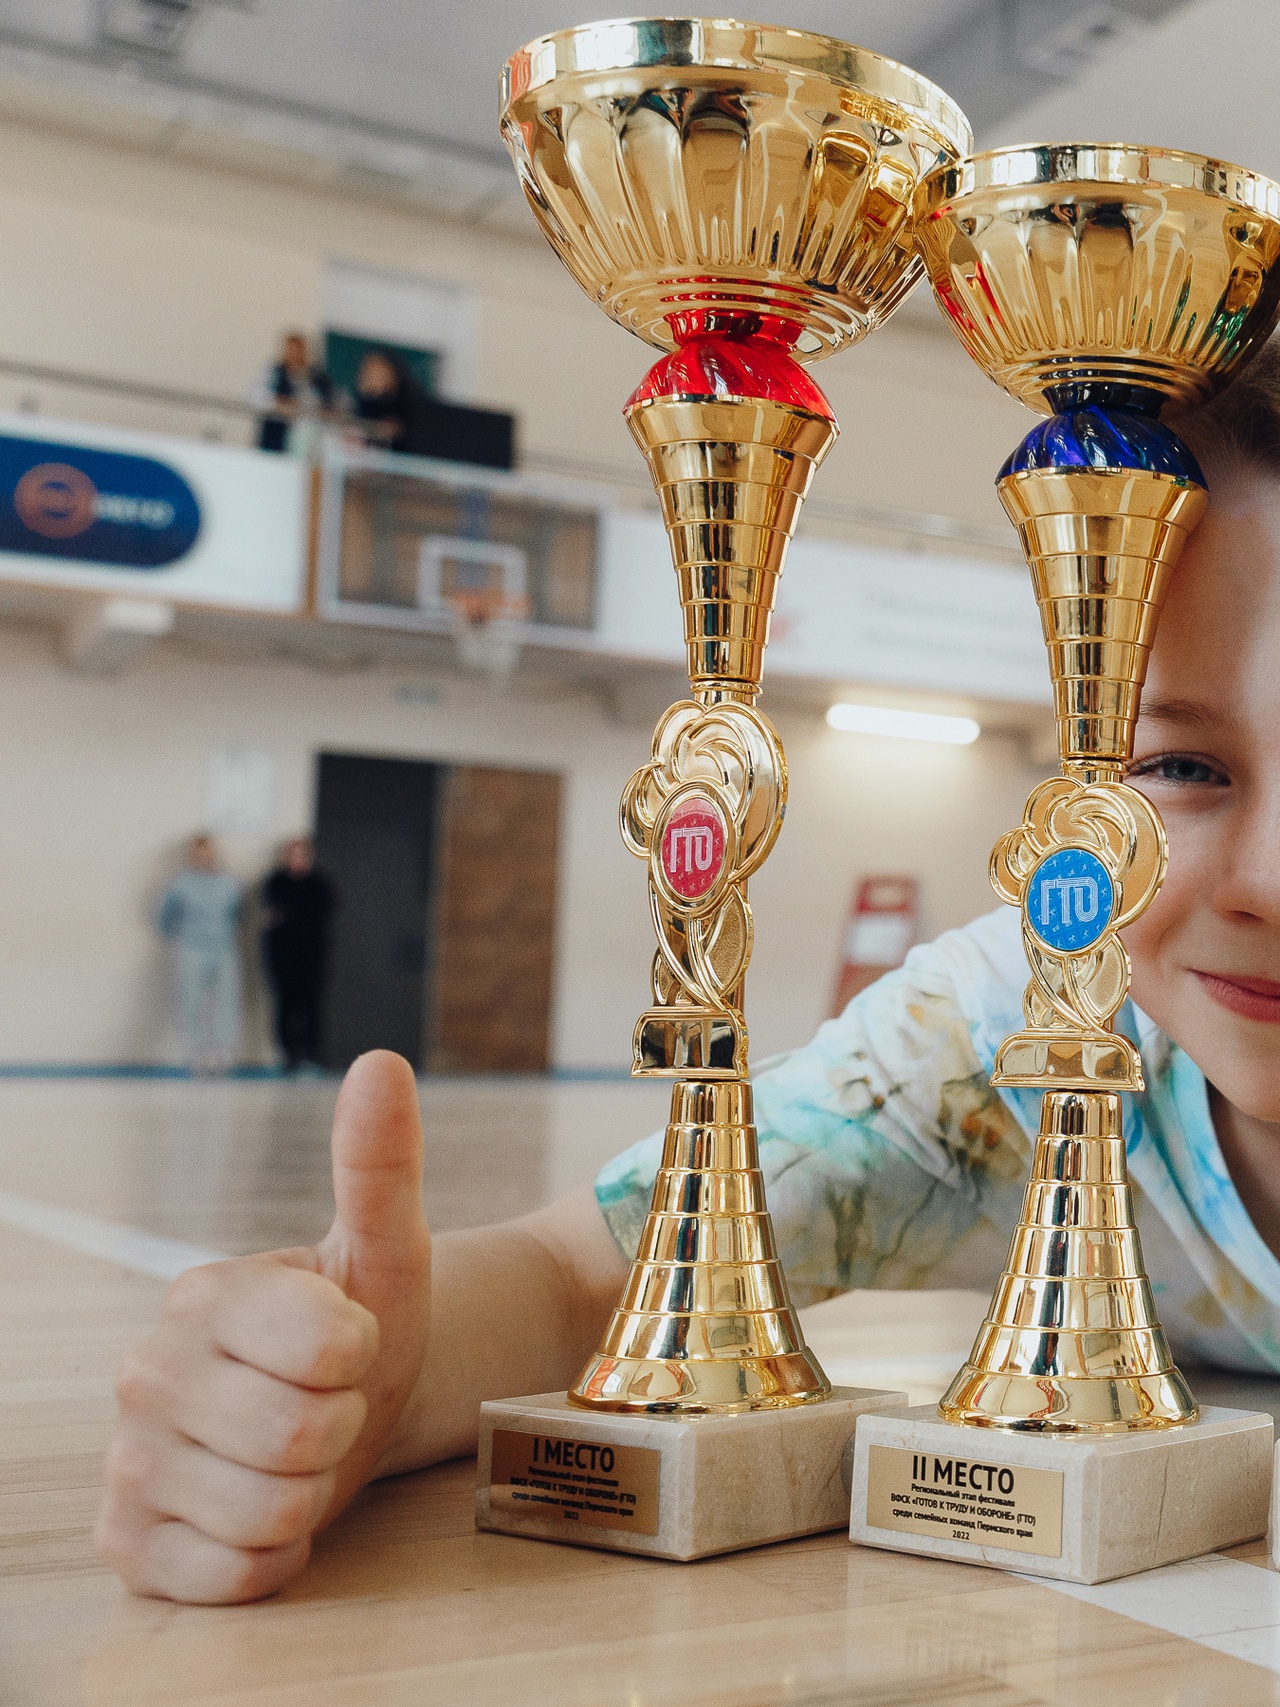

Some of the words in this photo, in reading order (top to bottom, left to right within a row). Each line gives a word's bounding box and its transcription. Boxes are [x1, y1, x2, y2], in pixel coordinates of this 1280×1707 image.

[670, 825, 713, 873] ГТО
[1040, 876, 1098, 925] ГТО
[532, 1437, 539, 1462] I
[544, 1439, 615, 1473] МЕСТО
[912, 1455, 926, 1481] II
[934, 1458, 1014, 1494] МЕСТО
[891, 1493, 911, 1504] ВФСК
[940, 1500, 945, 1509] К
[945, 1502, 969, 1514] ТРУДУ
[970, 1506, 976, 1515] И
[1017, 1513, 1036, 1526] (ГТО)
[911, 1483, 960, 1498] Региональный
[962, 1493, 977, 1501] этап
[978, 1494, 1015, 1507] фестиваля
[893, 1509, 912, 1518] среди
[914, 1513, 948, 1524] семейных
[949, 1518, 976, 1529] команд
[977, 1521, 1015, 1535] Пермского
[1016, 1529, 1033, 1538] края
[952, 1530, 970, 1540] 2022
